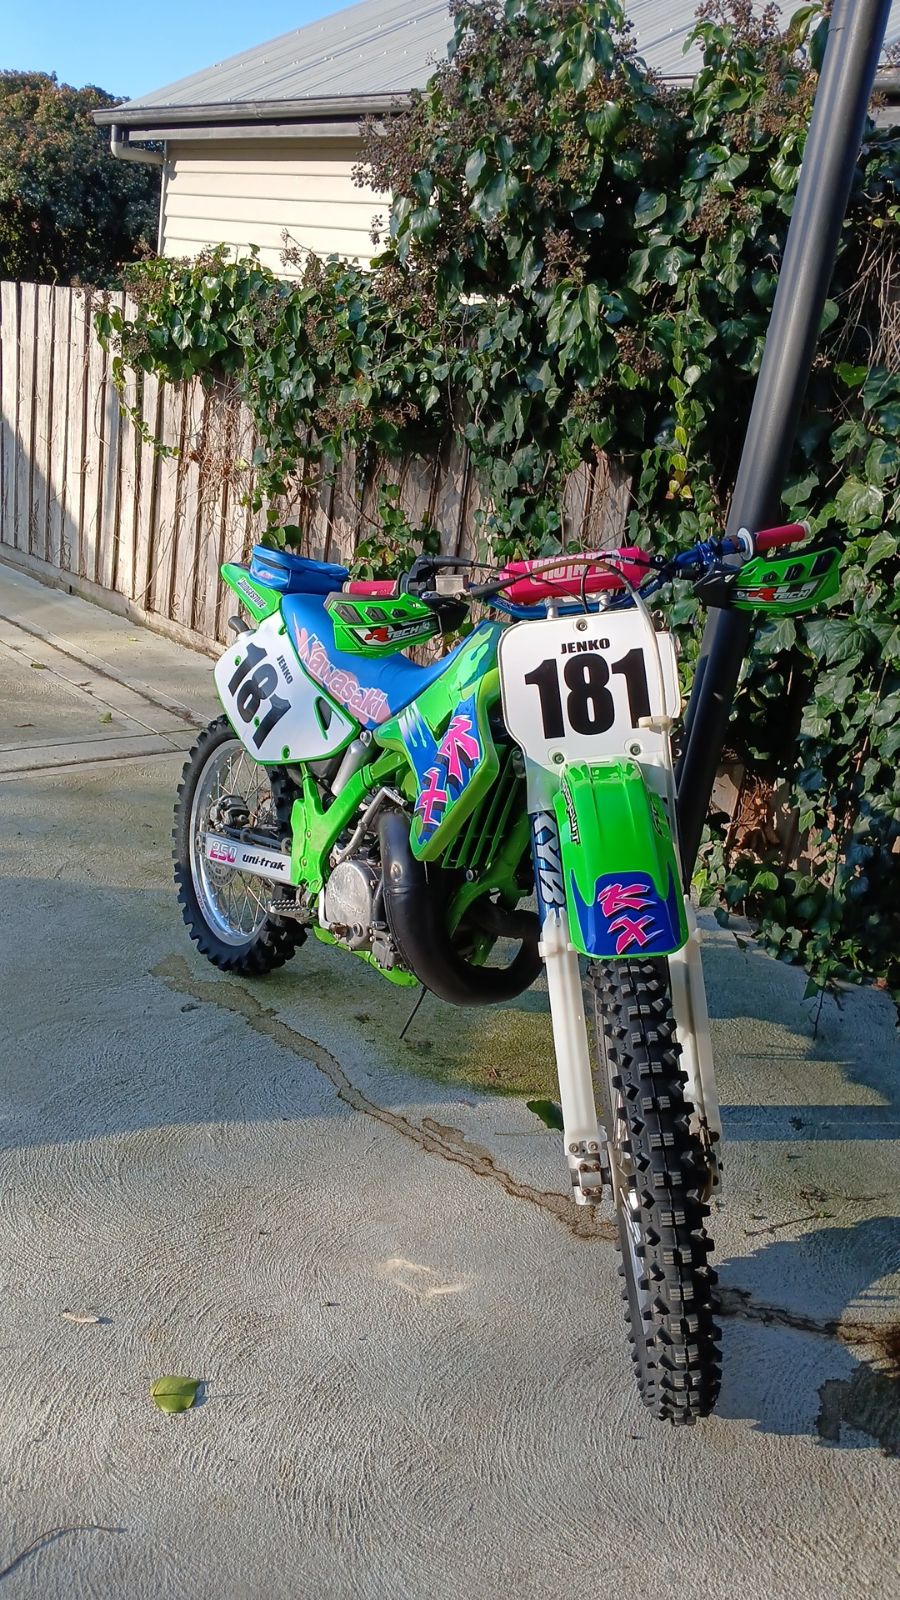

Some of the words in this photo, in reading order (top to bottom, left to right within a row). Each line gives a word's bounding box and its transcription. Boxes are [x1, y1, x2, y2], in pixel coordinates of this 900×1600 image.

[561, 637, 611, 655] JENKO
[276, 654, 294, 685] JENKO
[298, 634, 389, 721] Kawasaki
[228, 642, 292, 750] 181
[524, 648, 652, 740] 181
[209, 841, 237, 863] 250
[241, 853, 286, 872] uni-trak
